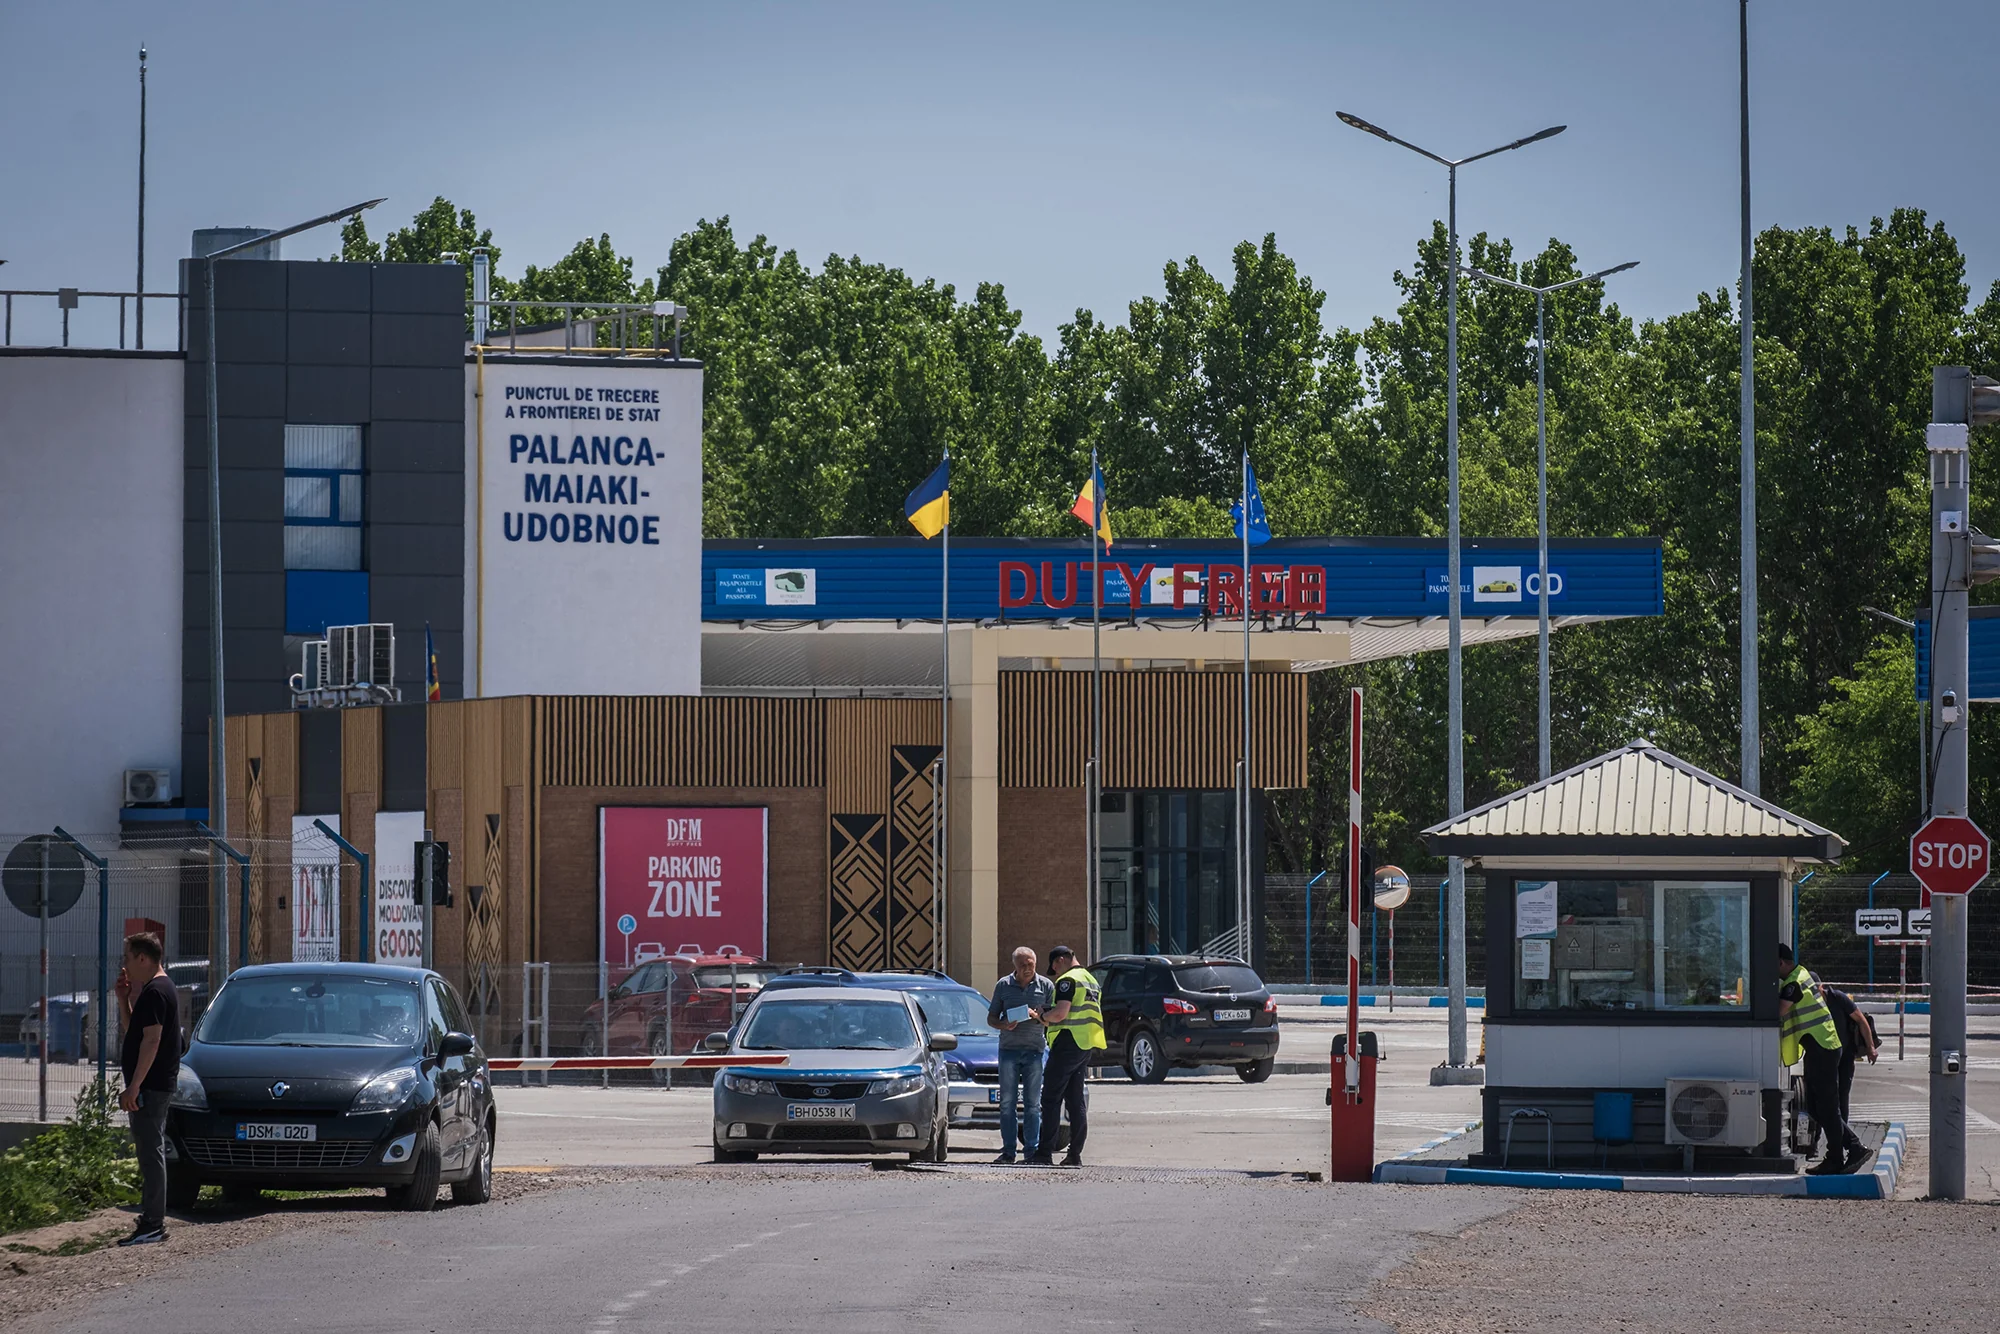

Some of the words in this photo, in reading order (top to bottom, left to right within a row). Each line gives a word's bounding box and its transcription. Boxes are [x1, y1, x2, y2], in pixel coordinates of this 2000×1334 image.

[505, 386, 570, 400] PUNCTUL
[575, 388, 593, 402] DE
[597, 389, 660, 403] TRECERE
[505, 406, 515, 418] A
[520, 406, 600, 420] FRONTIEREI
[605, 407, 624, 421] DE
[628, 408, 661, 422] STAT
[509, 434, 665, 466] PALANCA-
[524, 473, 650, 505] MAIAKI-
[503, 512, 660, 545] UDOBNOE
[999, 562, 1156, 609] DUTY
[1173, 564, 1322, 611] FREE
[1525, 573, 1563, 596] CD
[667, 818, 702, 841] DFM
[648, 856, 722, 878] PARKING
[1918, 842, 1983, 869] STOP
[379, 879, 415, 900] DISCOVE
[647, 880, 722, 917] ZONE
[379, 929, 422, 958] GOODS
[248, 1126, 273, 1138] DSM
[284, 1126, 309, 1139] 020
